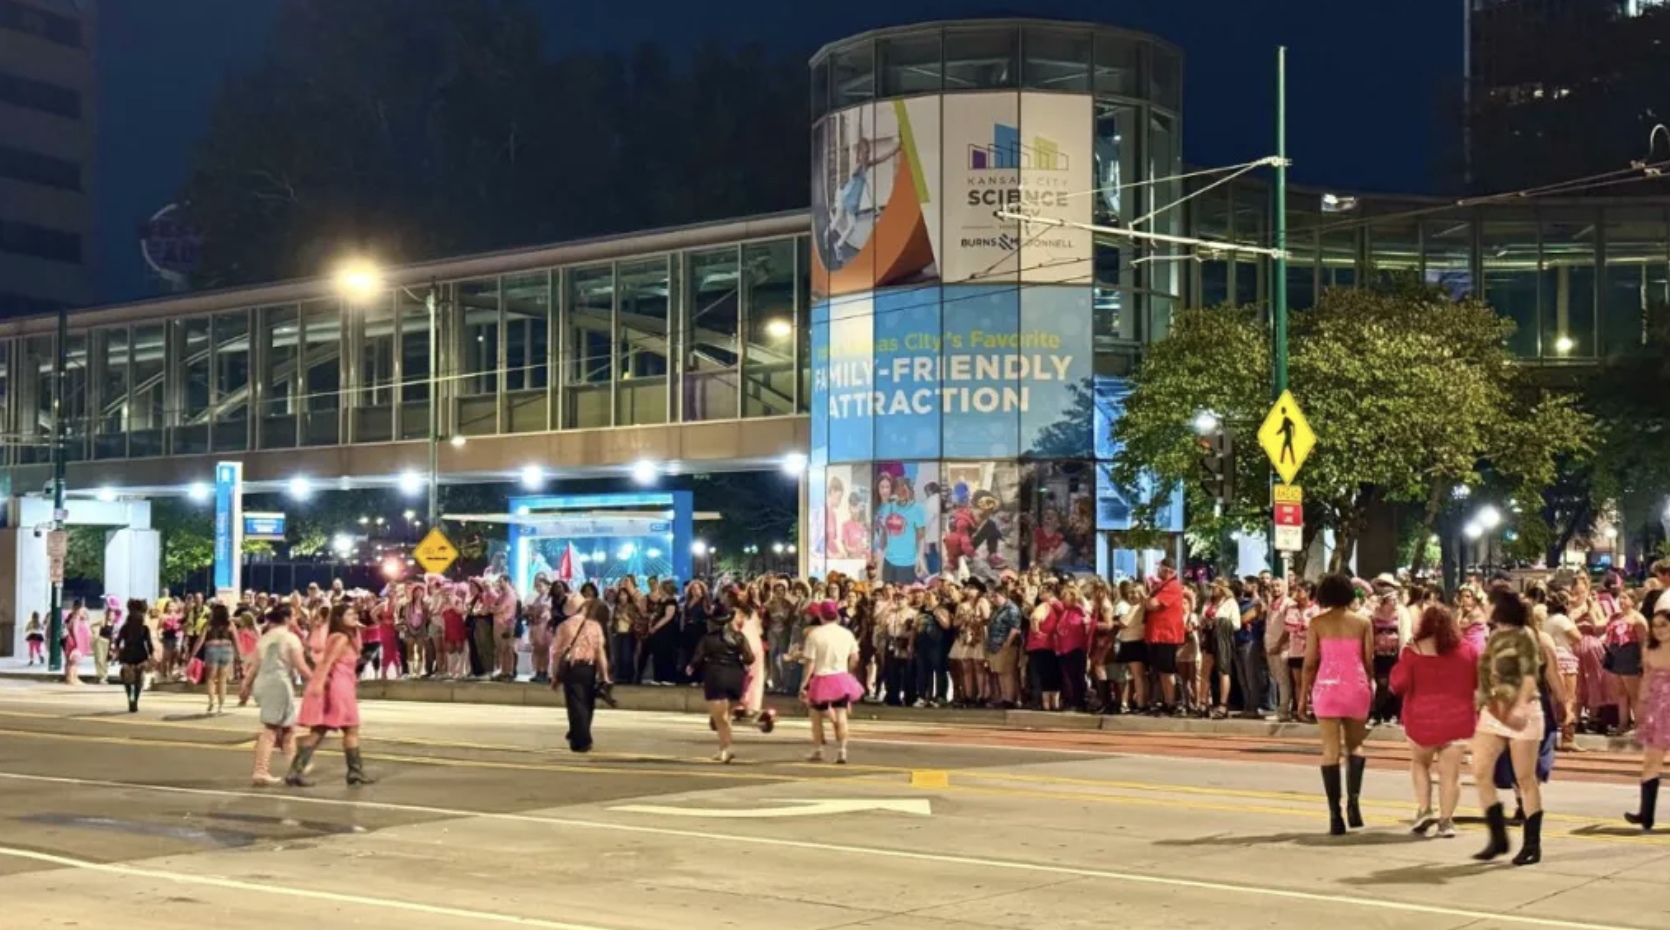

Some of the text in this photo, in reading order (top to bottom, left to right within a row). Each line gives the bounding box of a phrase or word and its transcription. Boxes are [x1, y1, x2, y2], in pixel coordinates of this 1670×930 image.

[967, 176, 1068, 187] KANSAS CITY
[967, 189, 1069, 207] SCIENCE
[961, 238, 996, 248] BURNS
[970, 330, 1060, 349] Favorite
[815, 354, 1073, 392] FAMILY-FRIENDLY
[829, 387, 1029, 418] ATTRACTION
